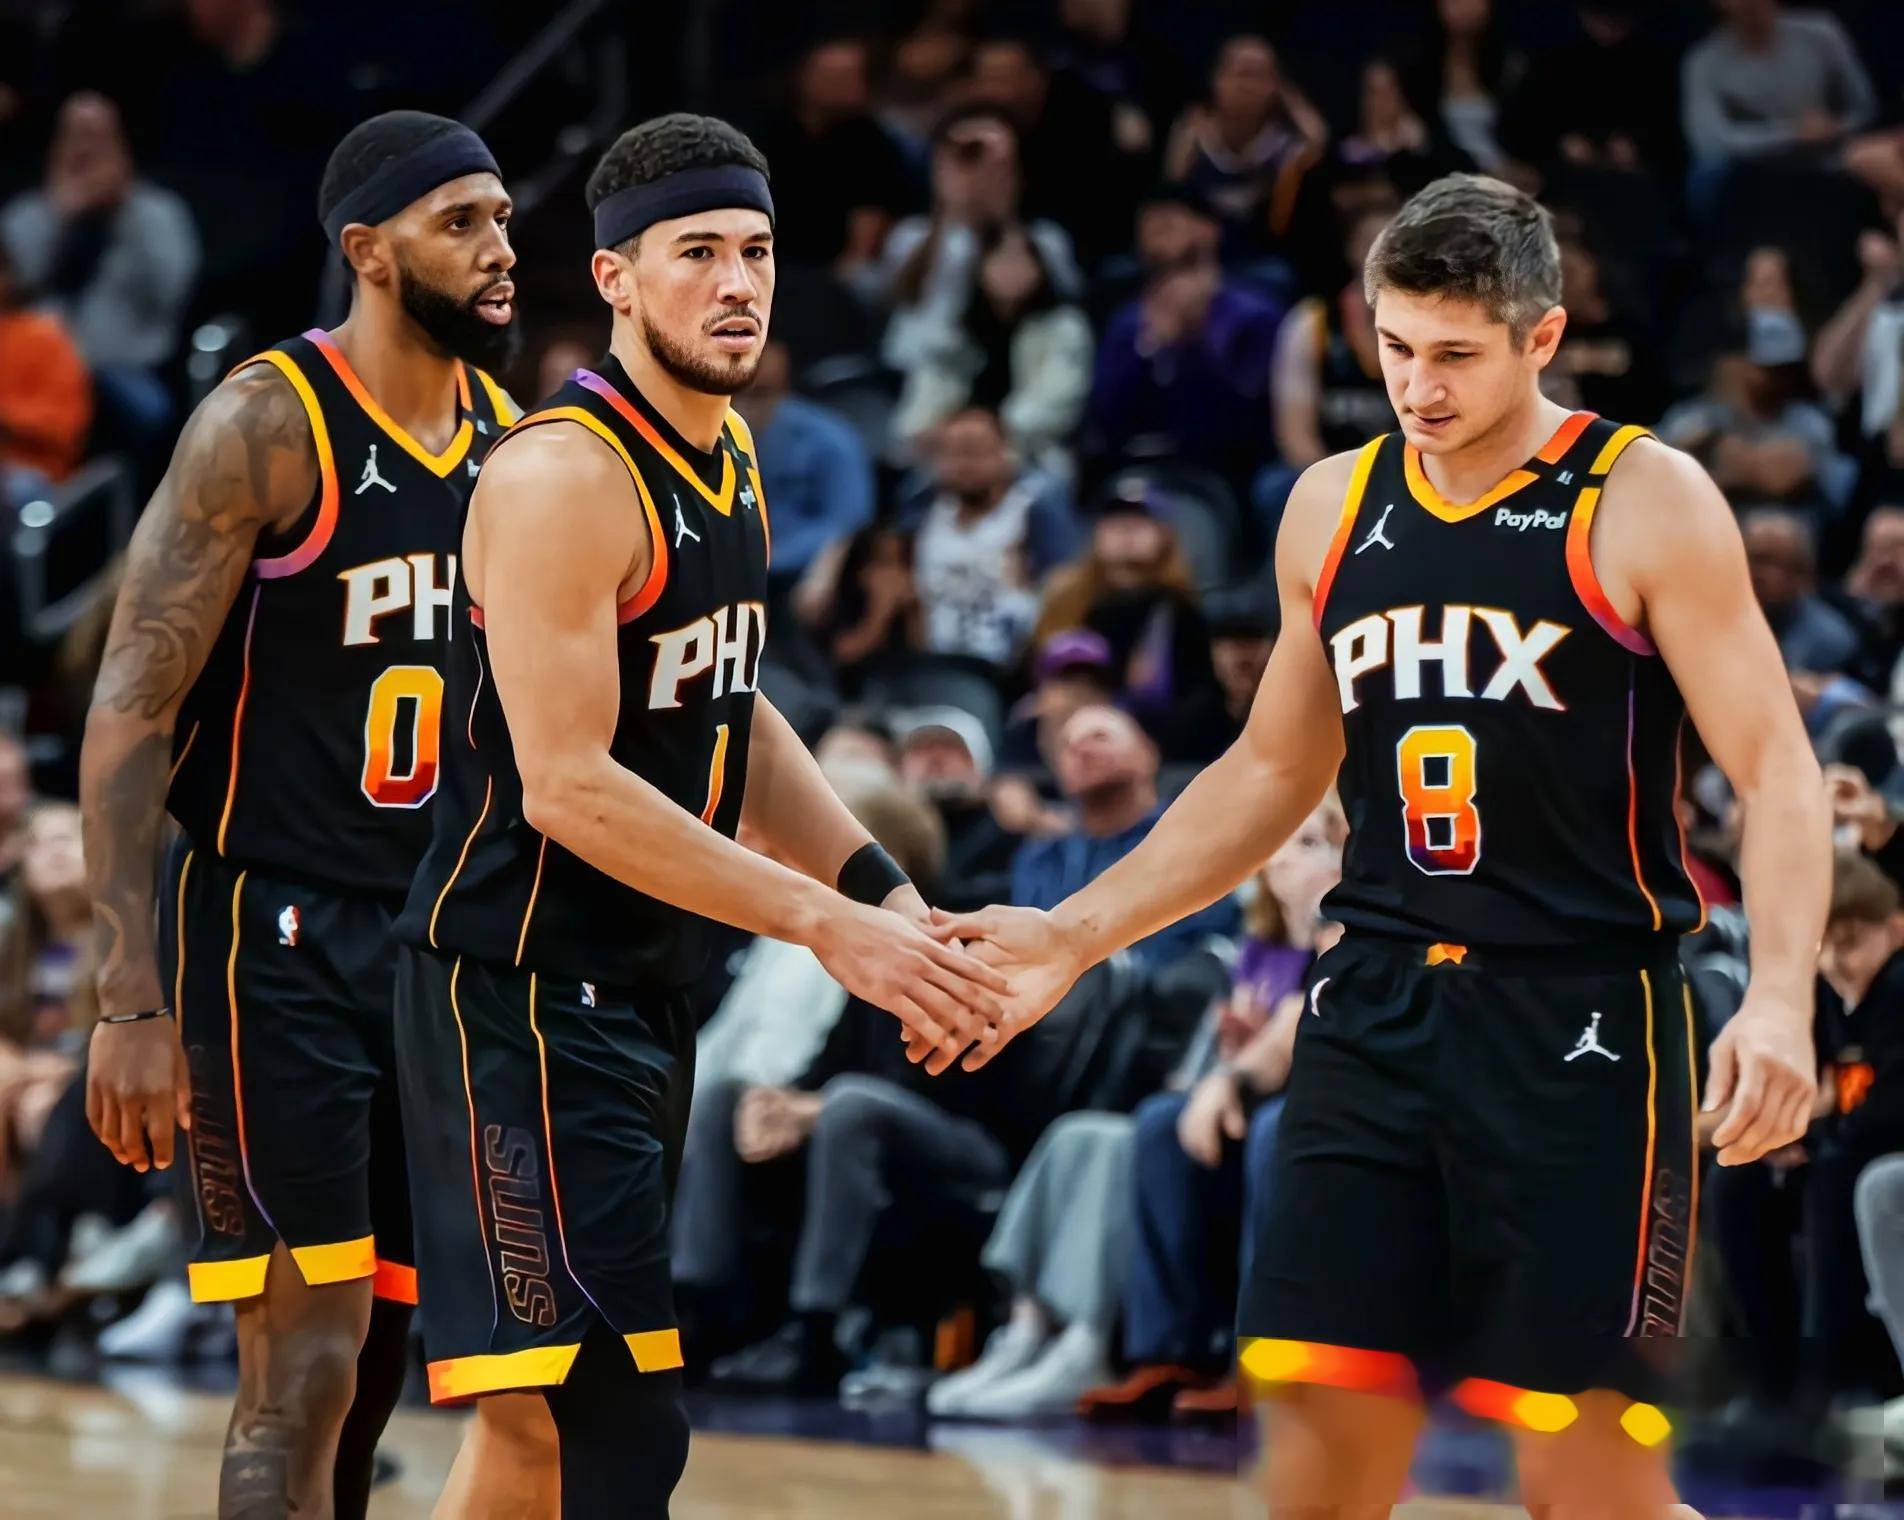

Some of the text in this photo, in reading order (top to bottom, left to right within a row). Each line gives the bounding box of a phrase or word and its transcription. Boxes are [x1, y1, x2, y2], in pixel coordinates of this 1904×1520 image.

[1494, 507, 1568, 532] PayPal
[336, 553, 457, 647] PH
[1329, 604, 1573, 715] PHX
[360, 664, 445, 810] 0
[1396, 724, 1482, 876] 8
[484, 1124, 557, 1326] SUNS
